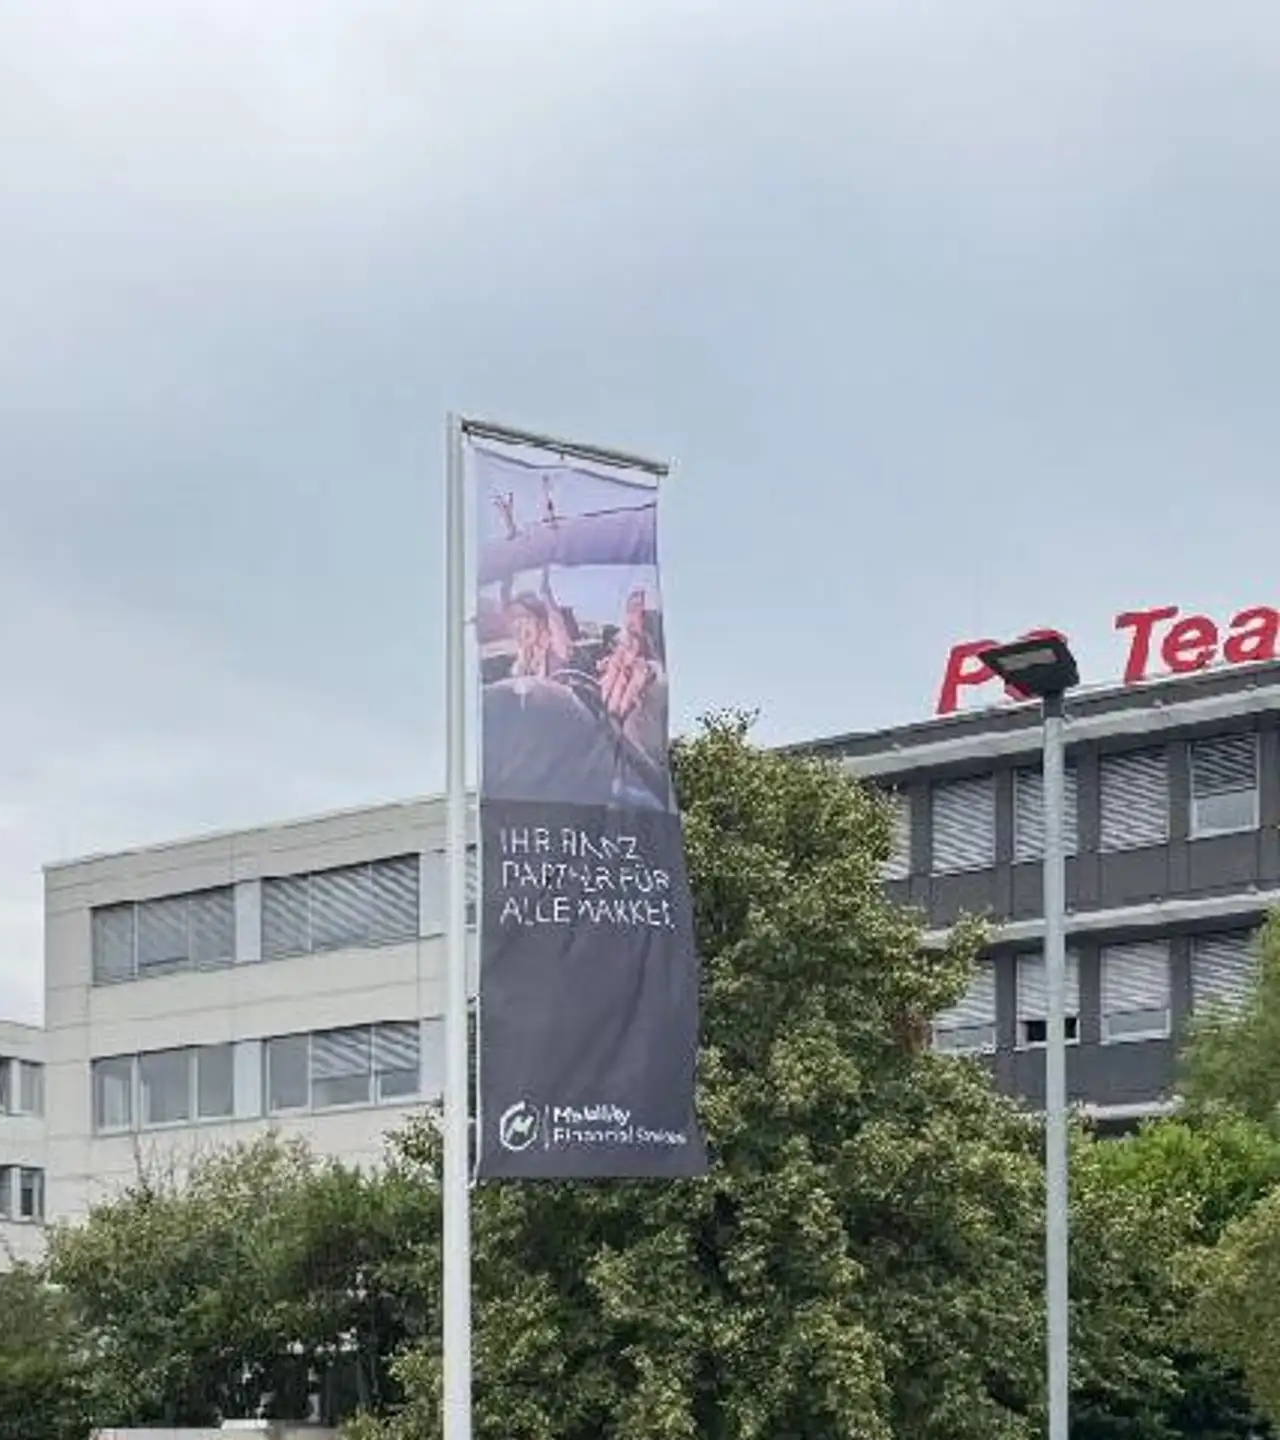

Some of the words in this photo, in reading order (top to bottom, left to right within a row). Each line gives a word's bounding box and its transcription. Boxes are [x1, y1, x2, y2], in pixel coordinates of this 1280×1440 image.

[500, 828, 551, 854] IHR
[620, 863, 672, 893] FÜR
[500, 896, 571, 926] ALLE
